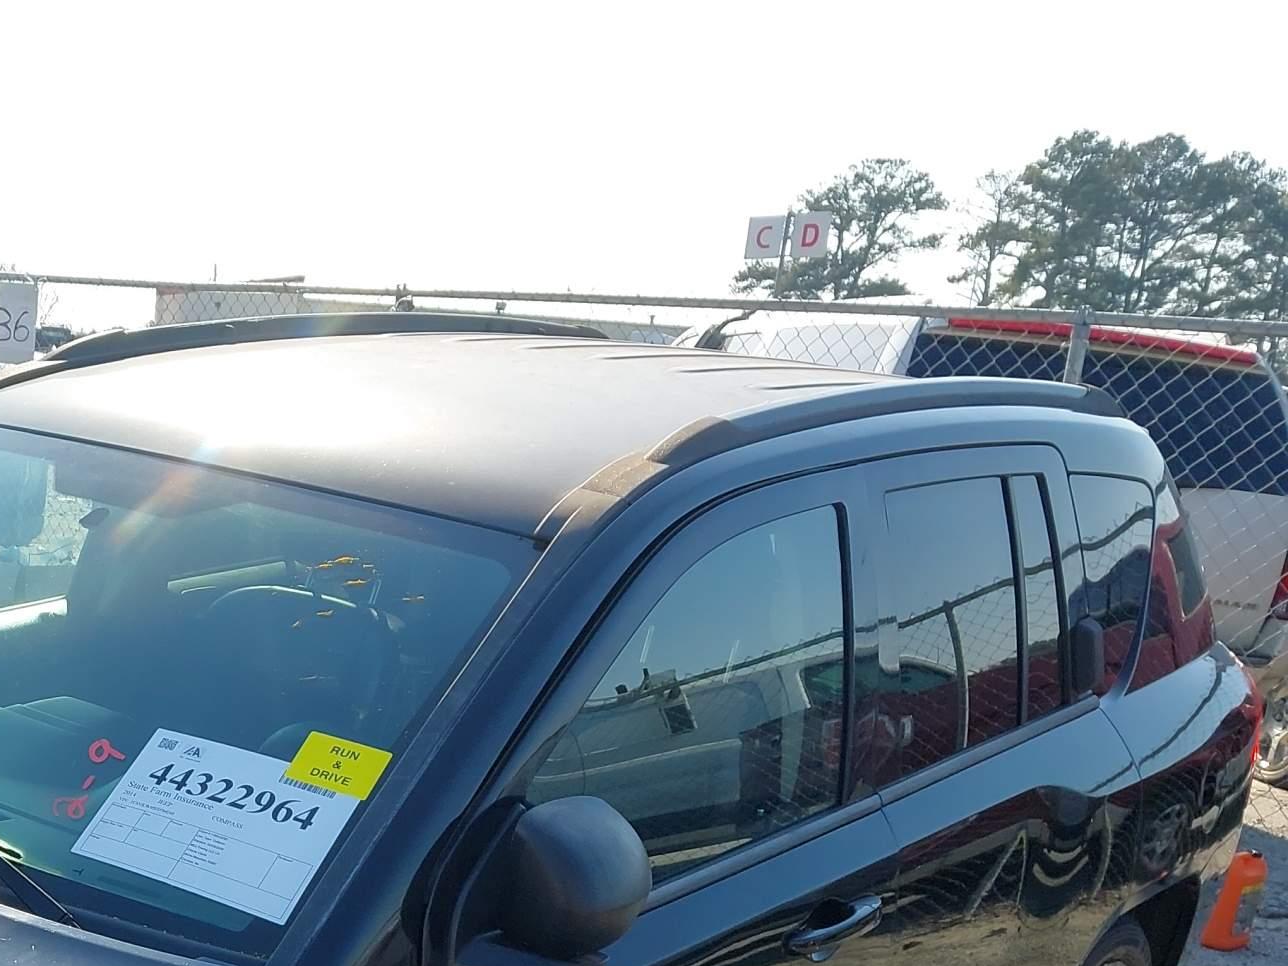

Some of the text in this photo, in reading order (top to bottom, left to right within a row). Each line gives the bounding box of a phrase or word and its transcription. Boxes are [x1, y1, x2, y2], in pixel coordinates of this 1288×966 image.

[756, 226, 773, 248] C
[801, 223, 820, 247] D
[329, 745, 361, 761] RUN
[332, 760, 342, 770] &
[309, 767, 353, 787] DRIVE
[127, 780, 149, 792] State
[150, 785, 172, 799] Farm
[173, 792, 215, 811] Insurance
[148, 763, 321, 831] 44322964
